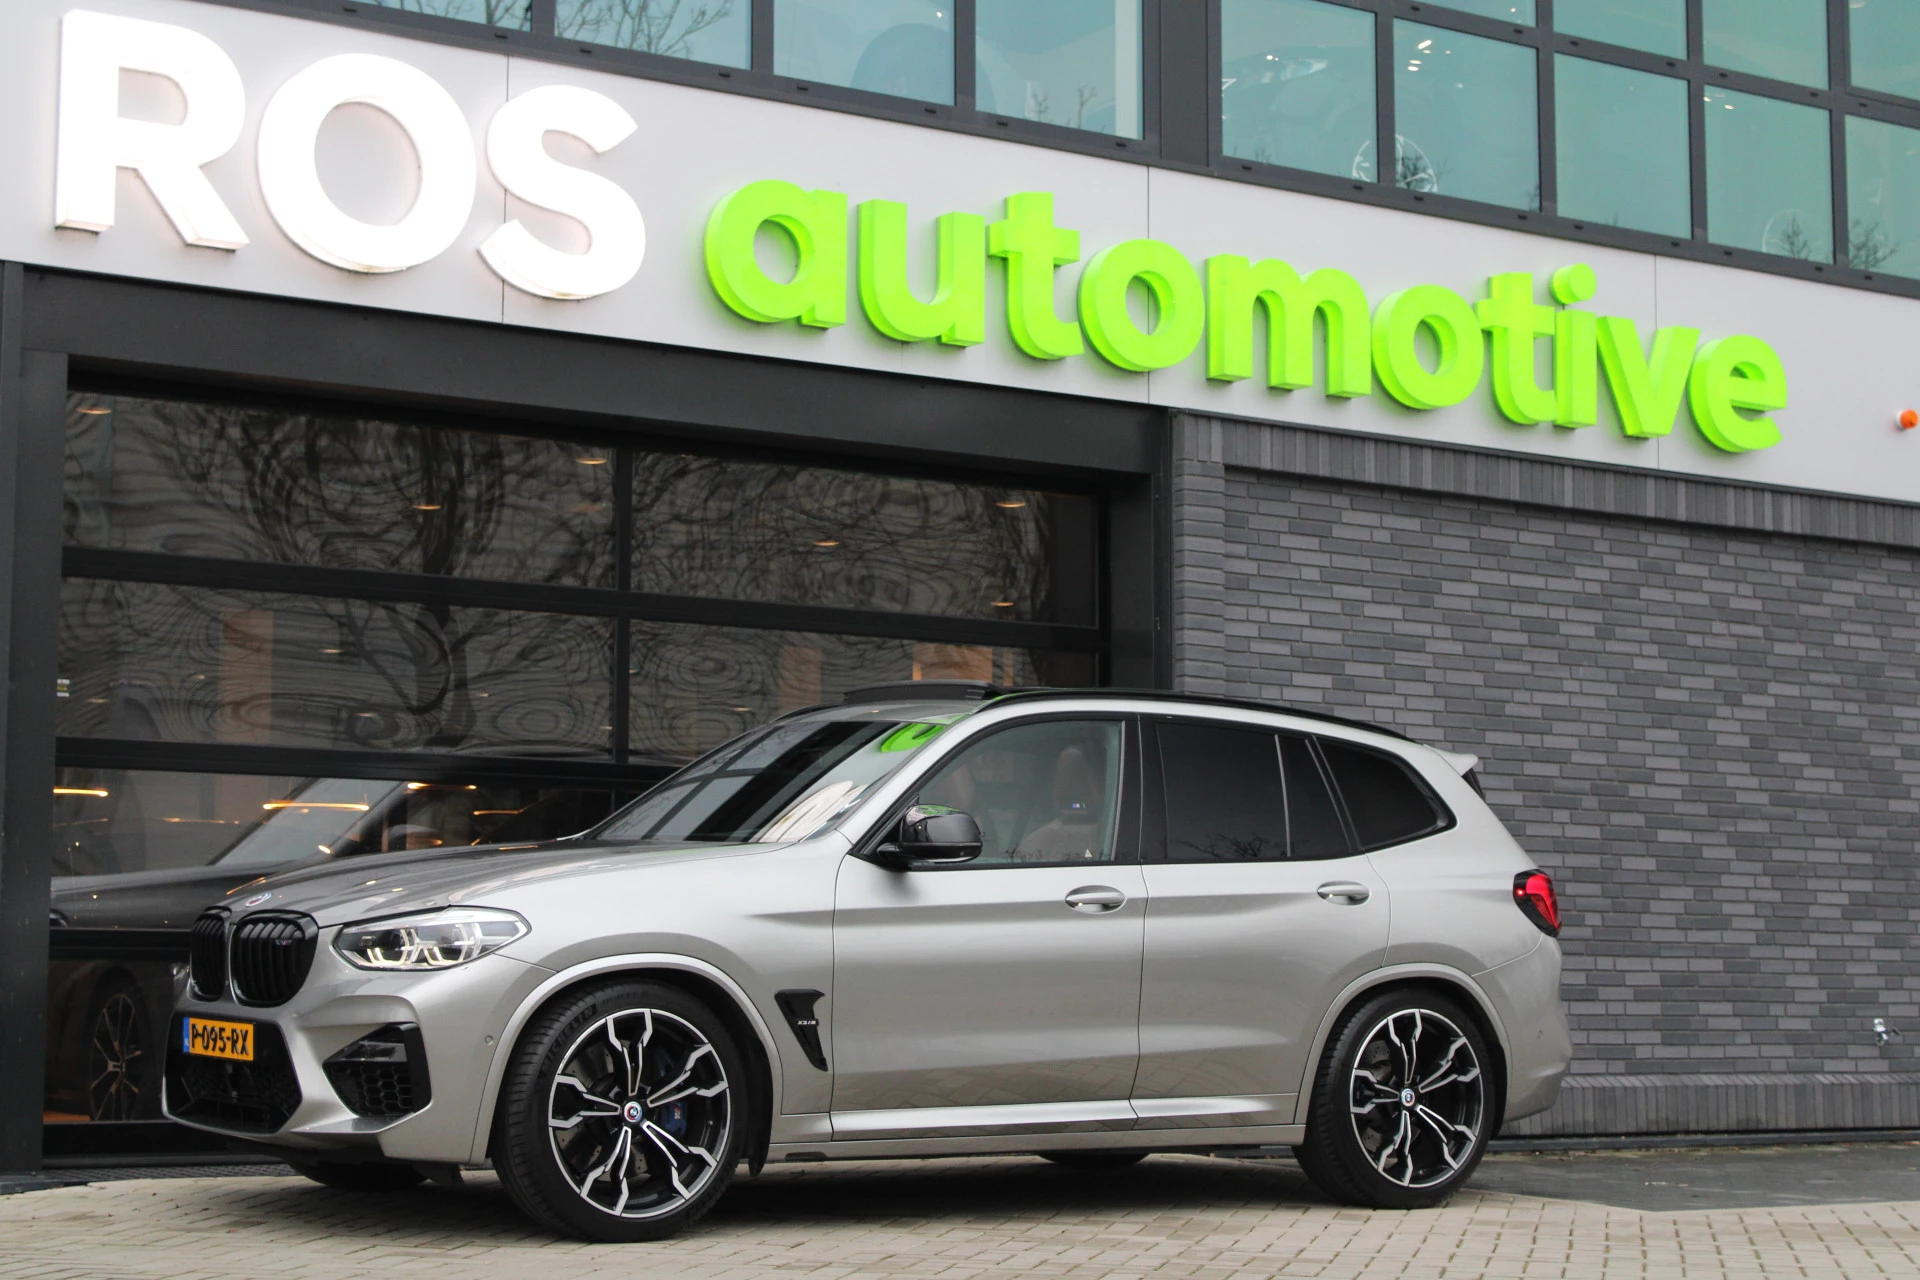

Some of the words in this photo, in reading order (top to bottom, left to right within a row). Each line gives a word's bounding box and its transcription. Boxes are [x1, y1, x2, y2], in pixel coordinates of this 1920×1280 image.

[55, 8, 646, 300] ROS
[705, 180, 1788, 453] automotive
[191, 1023, 249, 1056] P-095-RX
